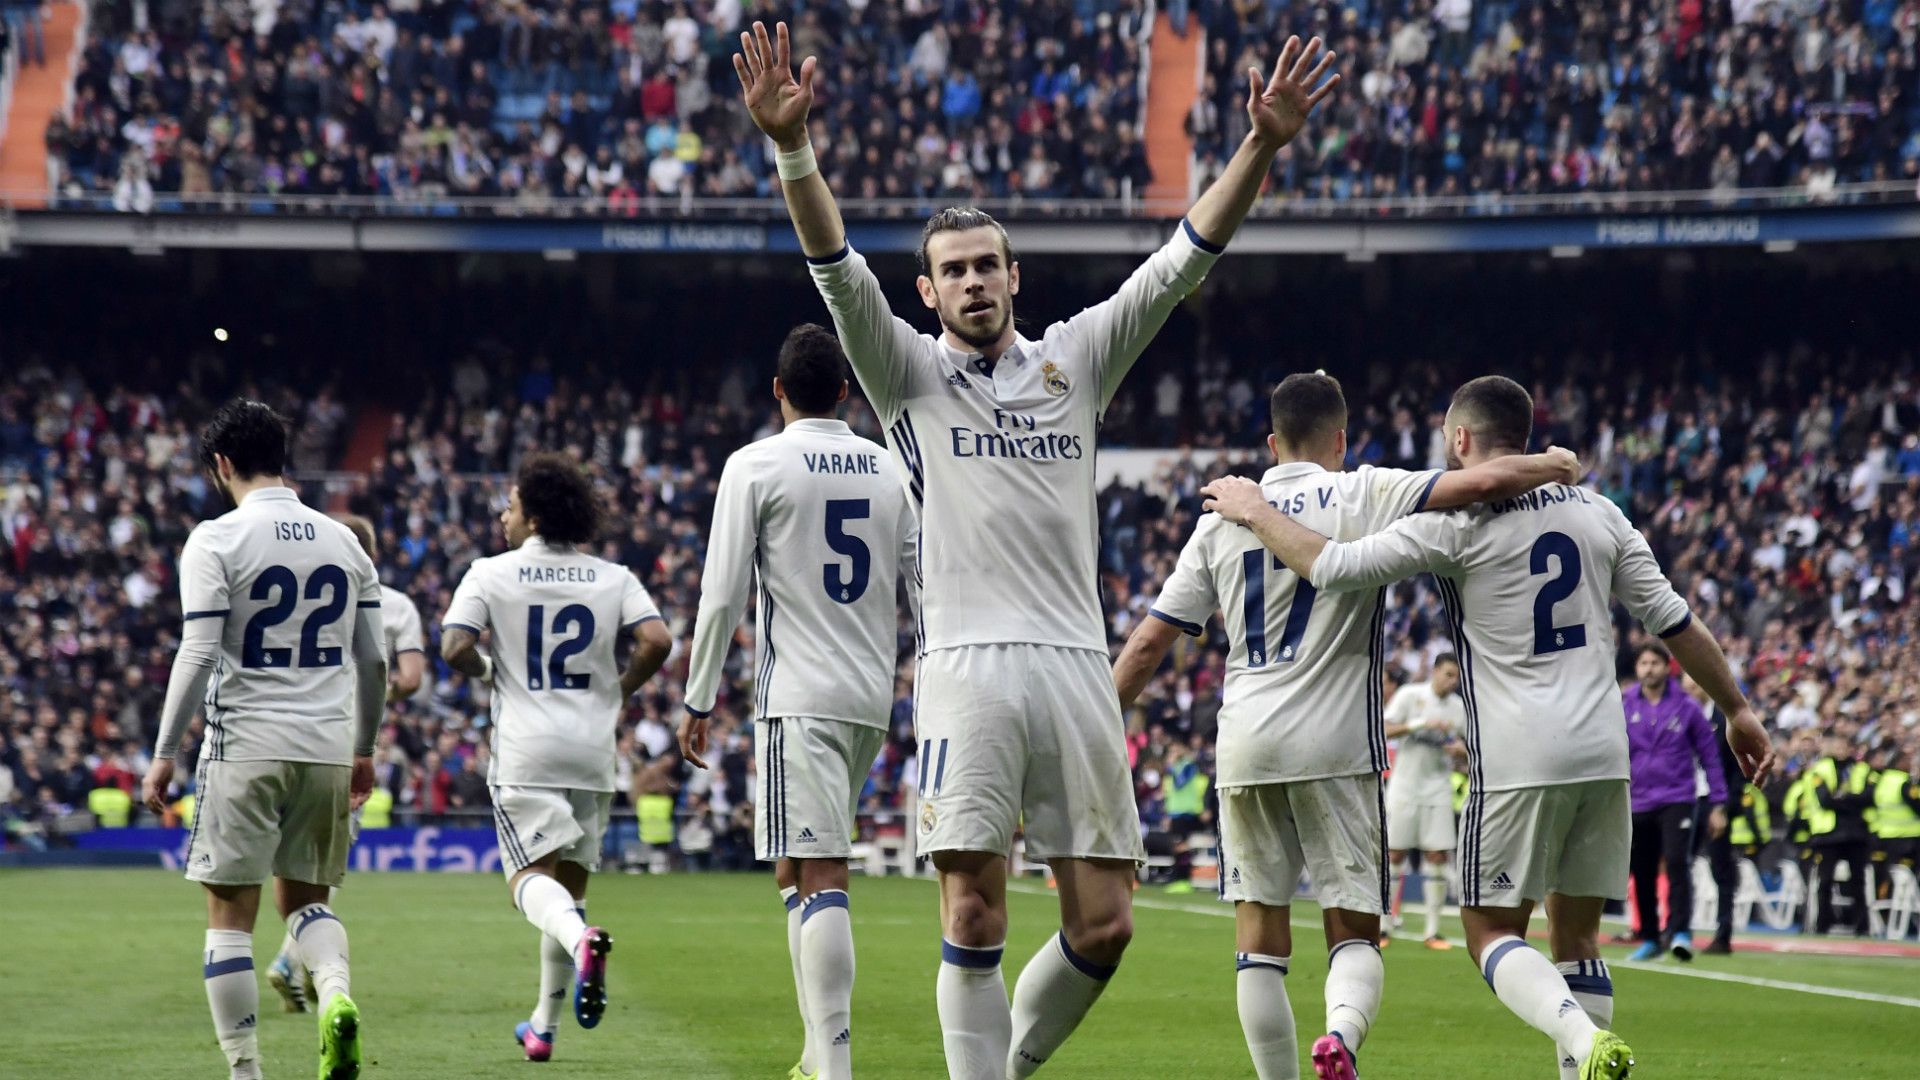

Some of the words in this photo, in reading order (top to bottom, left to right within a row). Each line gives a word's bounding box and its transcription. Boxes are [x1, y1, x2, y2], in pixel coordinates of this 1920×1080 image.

[993, 408, 1036, 431] Fly
[950, 427, 1082, 460] Emirates
[804, 453, 880, 475] VARANE
[1317, 486, 1337, 509] V.
[823, 498, 871, 604] 5
[519, 567, 596, 583] MARCELO
[1530, 531, 1587, 656] 2
[242, 564, 348, 668] 22
[527, 604, 595, 691] 12
